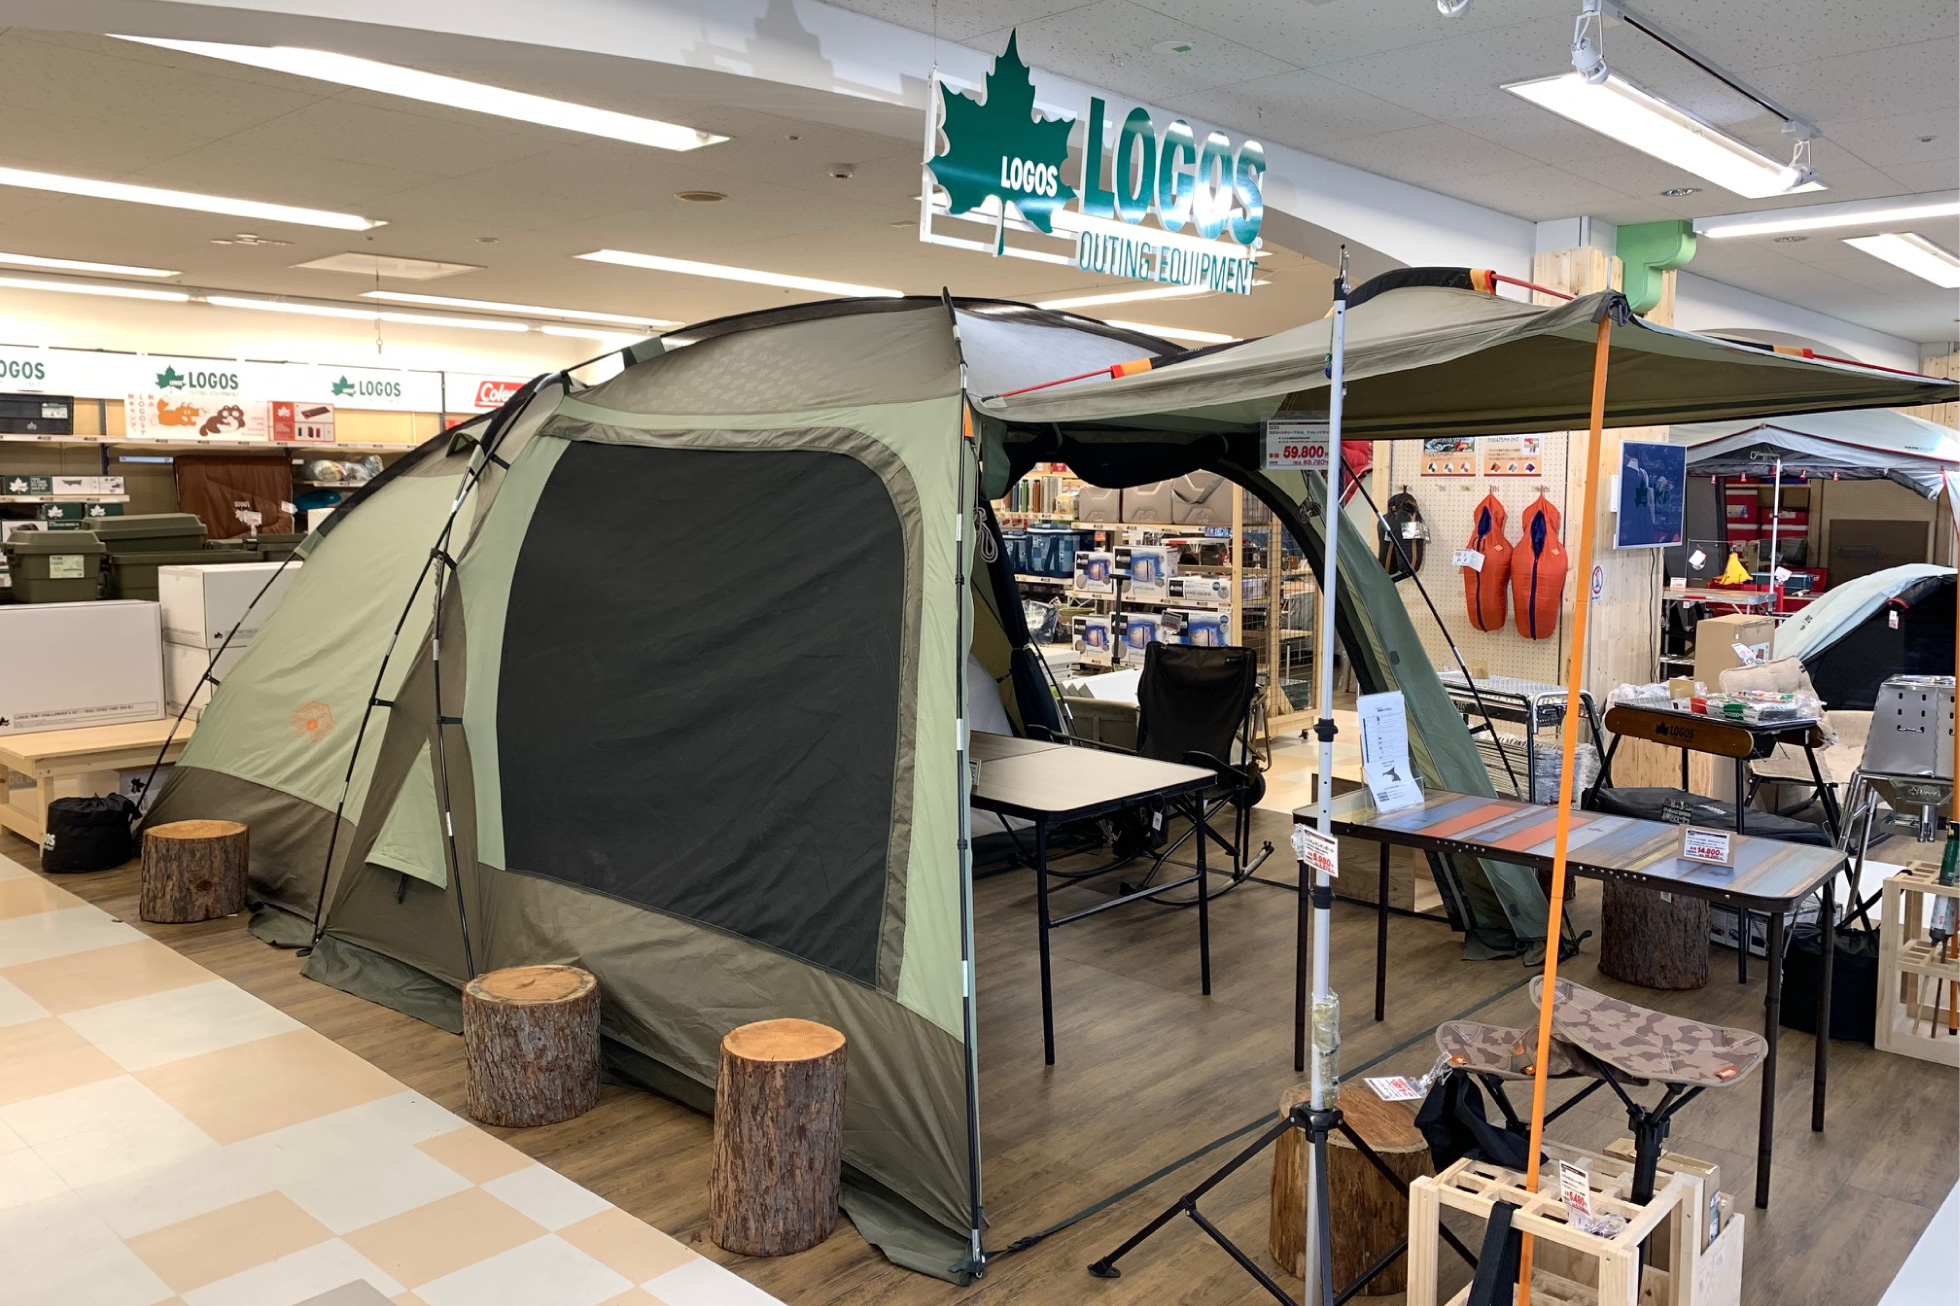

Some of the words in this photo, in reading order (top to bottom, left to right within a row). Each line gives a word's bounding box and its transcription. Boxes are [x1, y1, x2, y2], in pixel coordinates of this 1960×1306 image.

[1001, 155, 1058, 198] LOGOS
[1080, 96, 1267, 246] LOGOS
[1078, 230, 1151, 281] OUTING
[1158, 245, 1259, 296] EQUIPMENT
[188, 371, 239, 390] LOGOS
[359, 380, 401, 397] LOGOS
[480, 382, 517, 402] Cole
[1670, 725, 1695, 739] LOGOS
